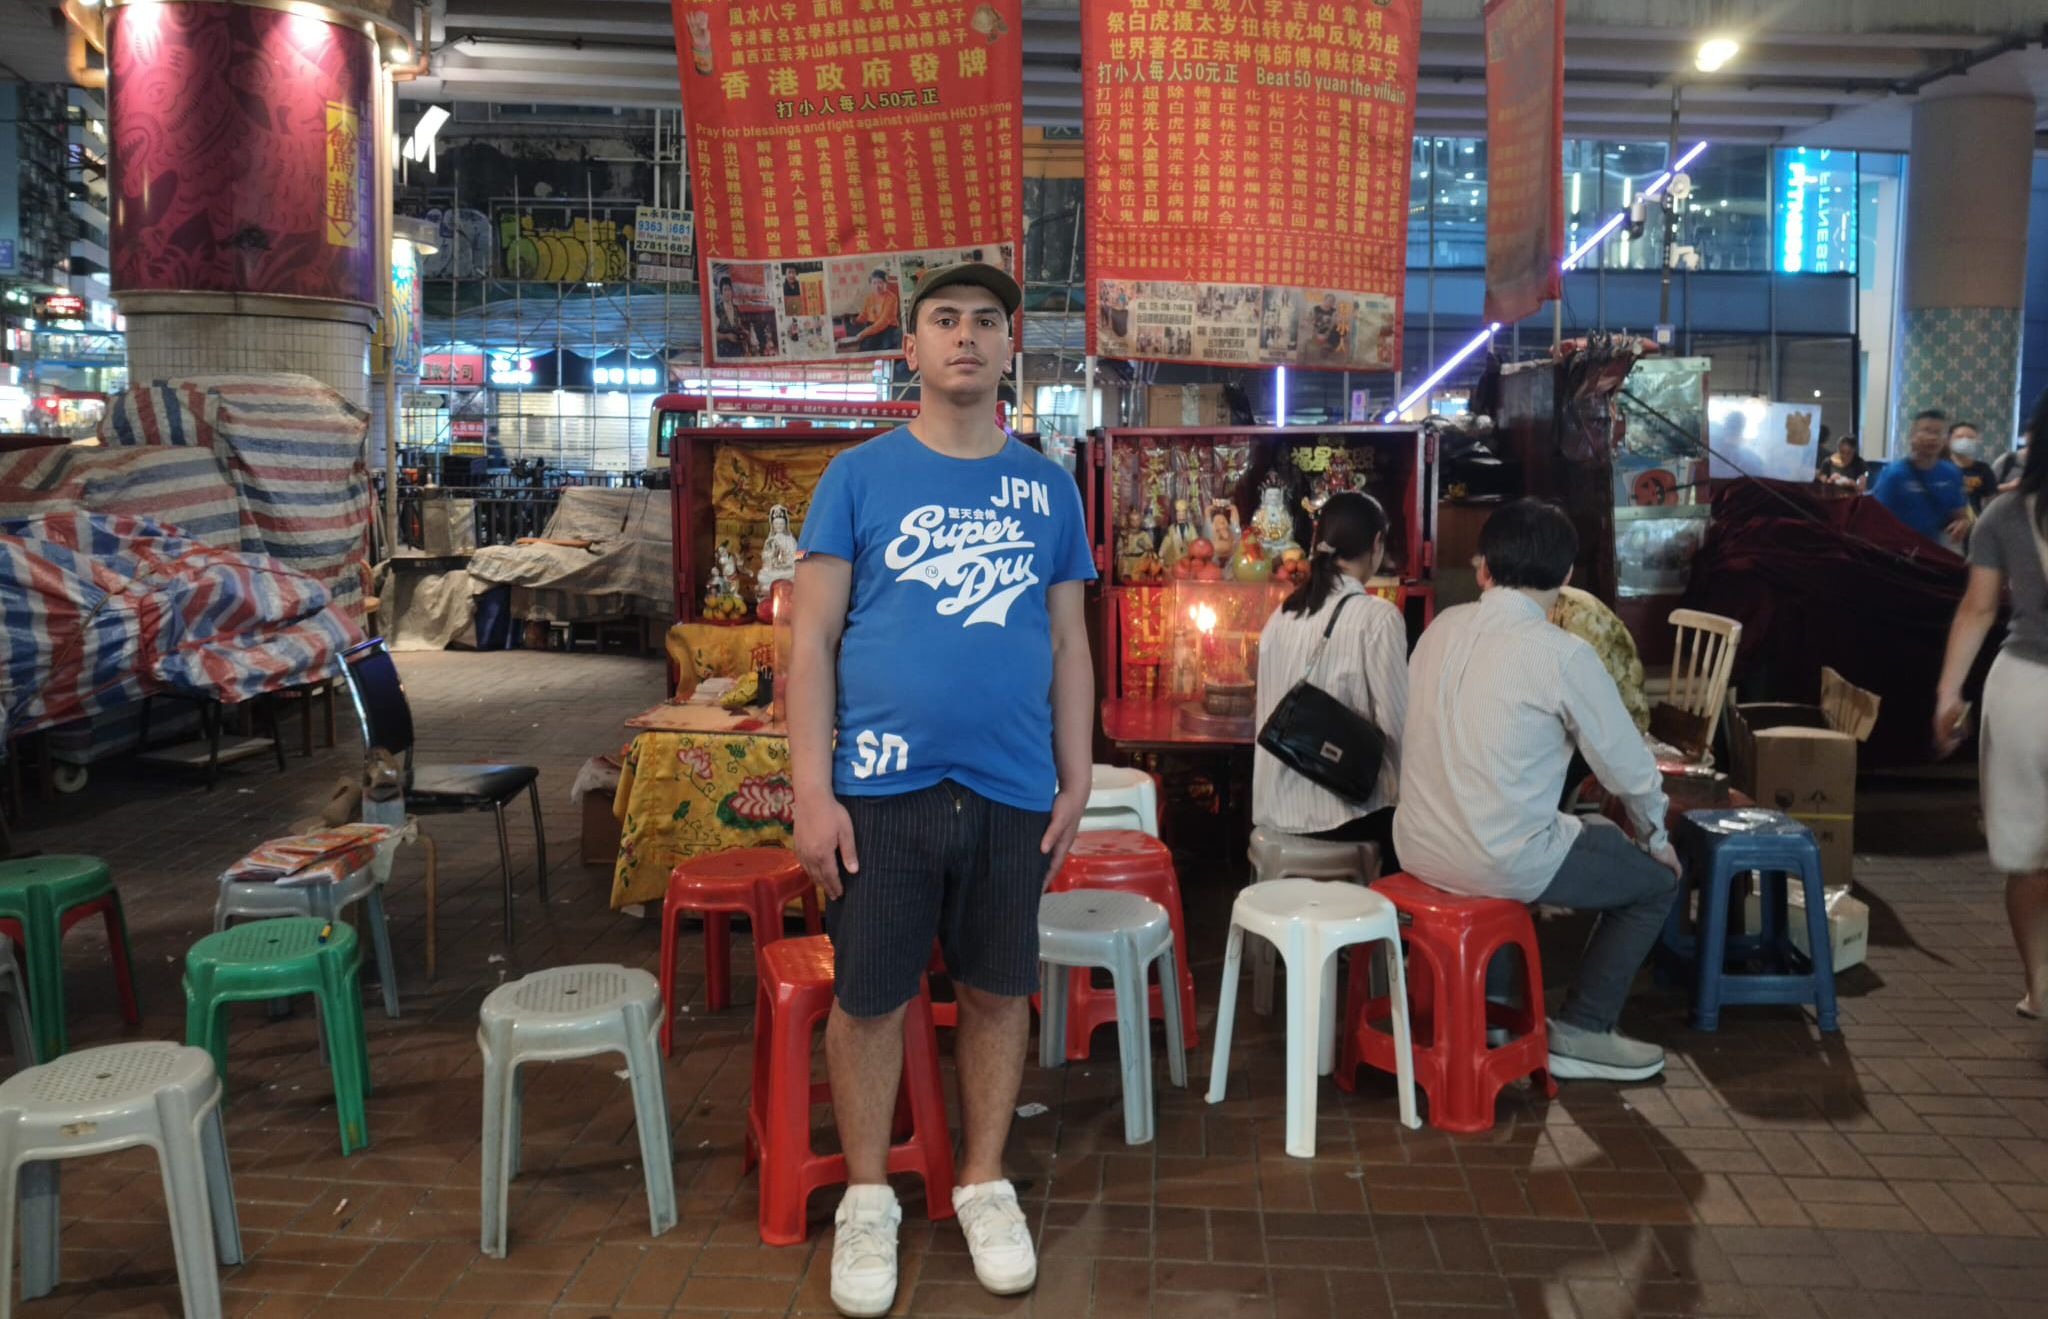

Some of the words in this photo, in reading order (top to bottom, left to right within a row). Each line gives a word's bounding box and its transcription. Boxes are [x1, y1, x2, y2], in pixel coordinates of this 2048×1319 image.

[729, 3, 797, 27] 風水八字
[720, 47, 988, 100] 香港政府發牌
[1098, 60, 1240, 84] 打小人每人50元正
[1256, 66, 1291, 87] Beat
[1294, 69, 1311, 88] 50
[1315, 75, 1347, 93] yuan
[1350, 76, 1371, 97] the
[1374, 83, 1407, 104] villain
[776, 87, 940, 119] 打小人每人50元正
[695, 123, 720, 139] Pray
[722, 127, 740, 138] for
[743, 124, 801, 137] blessings
[804, 121, 825, 133] and
[828, 118, 853, 133] fight
[856, 114, 902, 129] against
[905, 110, 947, 123] villains
[950, 107, 976, 120] HKD
[639, 220, 662, 232] 9363
[747, 402, 767, 411] LIGHT
[803, 405, 826, 413] SEATS
[990, 475, 1050, 517] JPN
[885, 505, 1025, 569] Super
